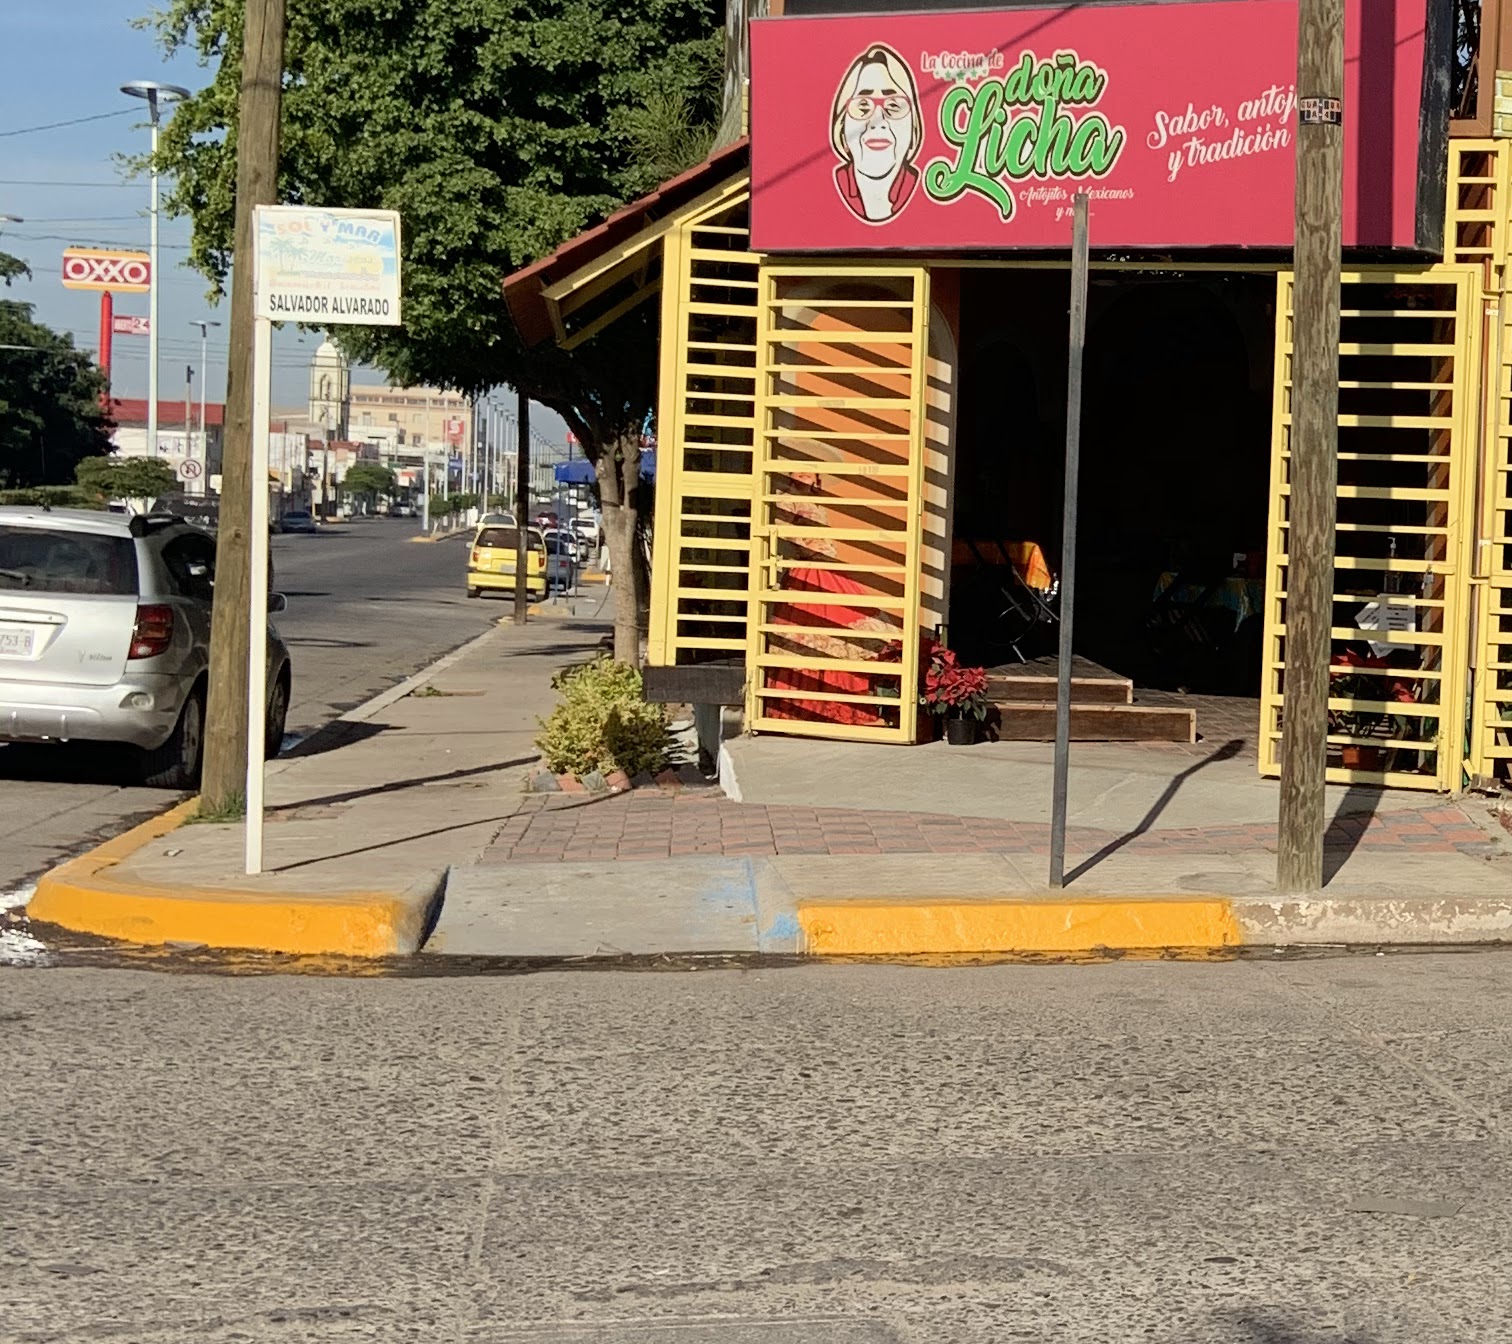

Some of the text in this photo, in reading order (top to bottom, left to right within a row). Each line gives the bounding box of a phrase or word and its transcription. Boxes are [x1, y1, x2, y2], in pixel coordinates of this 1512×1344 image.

[922, 49, 1002, 69] La Cocina de
[1004, 53, 1105, 105] doña
[1146, 103, 1229, 149] Sabor,
[925, 80, 1123, 221] Licha
[1167, 123, 1291, 182] y tradición
[1019, 186, 1067, 207] Antojitos
[1055, 207, 1064, 221] y
[338, 222, 381, 243] MAR
[66, 258, 147, 283] OXXO
[270, 294, 389, 316] SALVADOR ALVARADO
